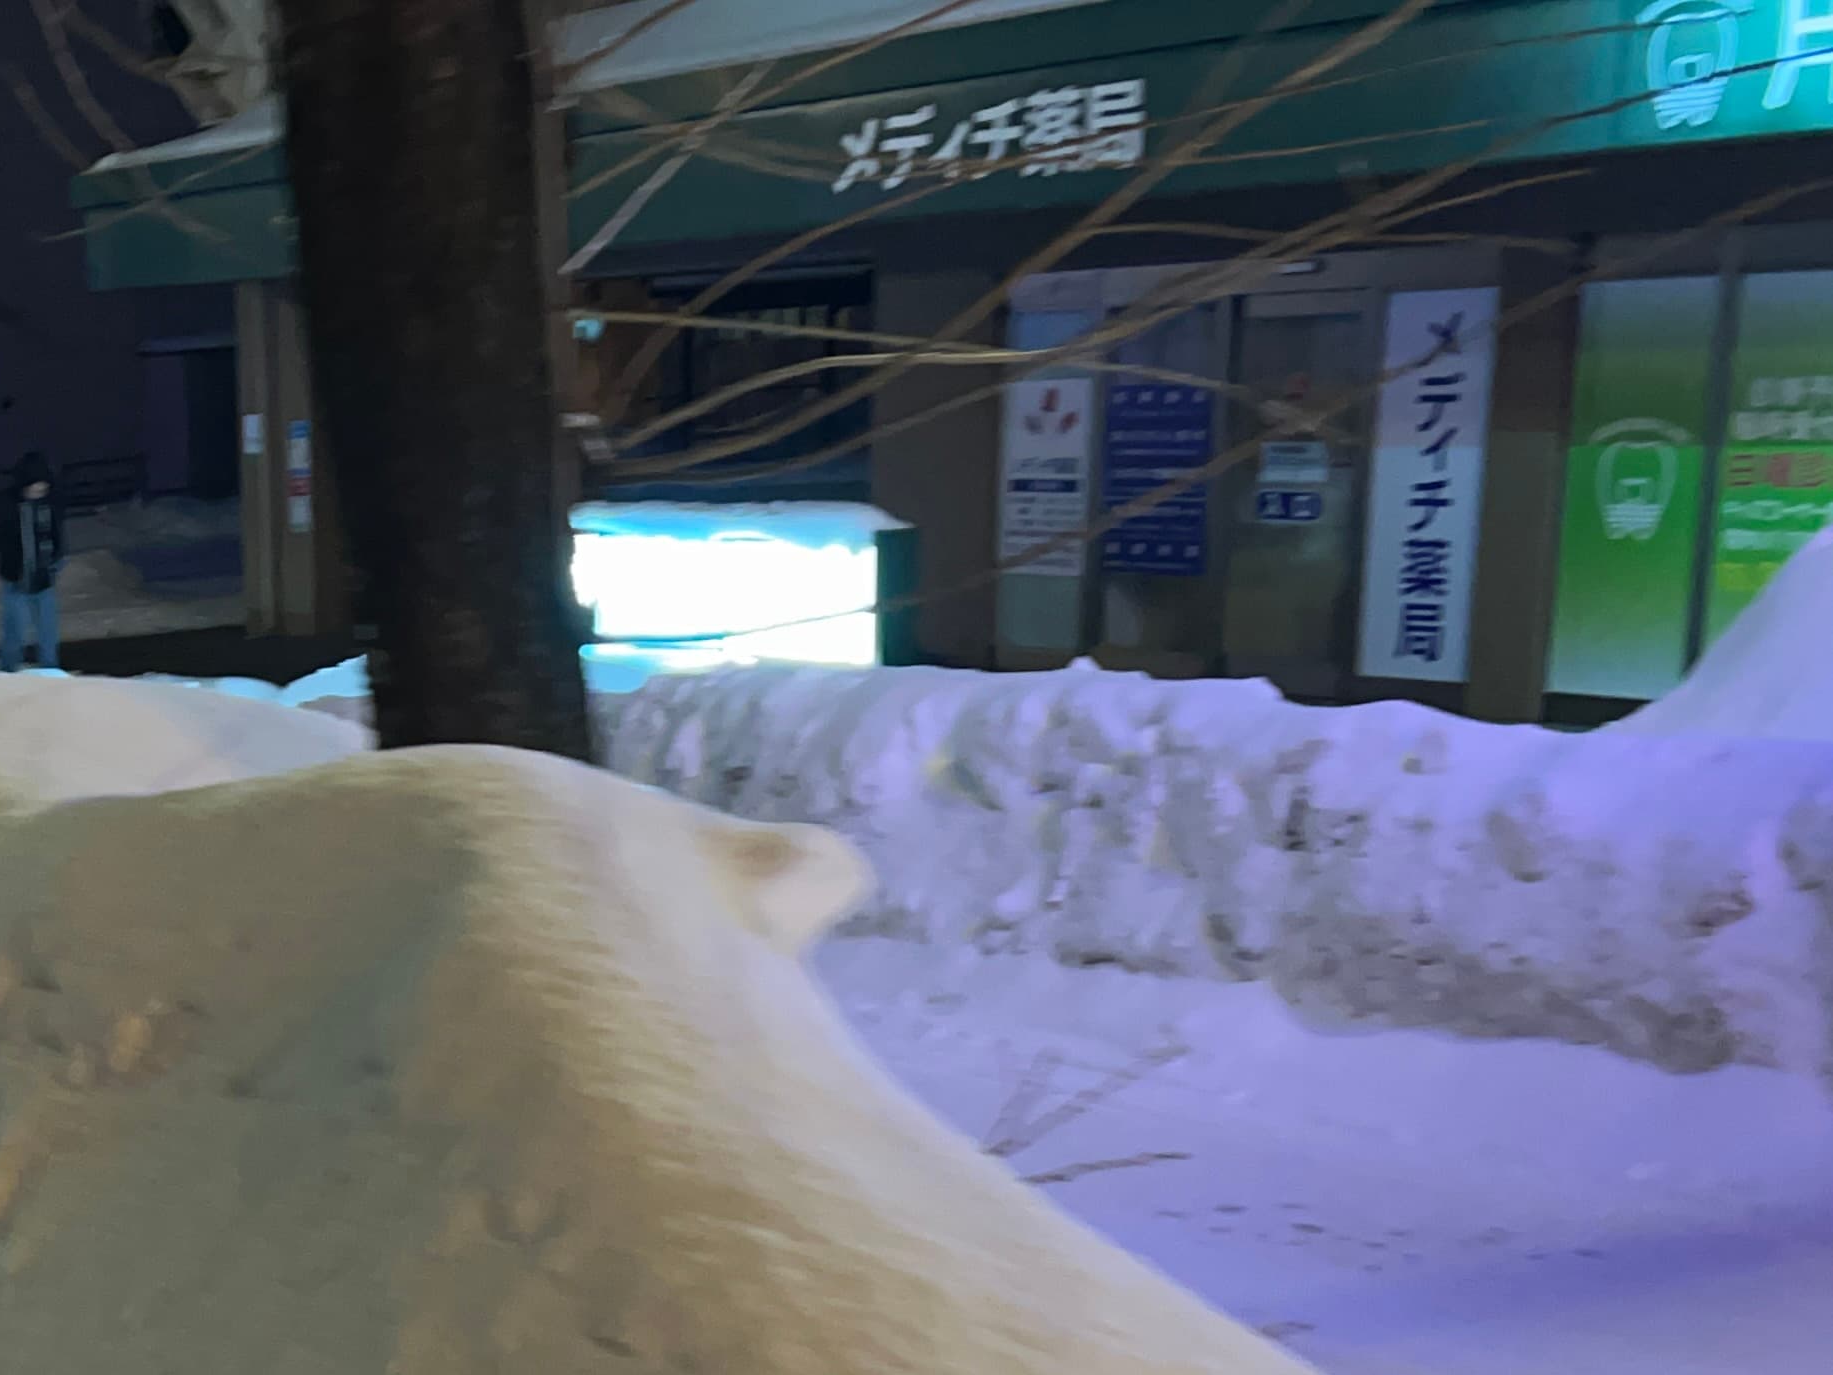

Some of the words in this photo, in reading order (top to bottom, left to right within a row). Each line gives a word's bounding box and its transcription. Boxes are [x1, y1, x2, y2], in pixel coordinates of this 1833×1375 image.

[831, 78, 1148, 194] メディチ薬局
[1391, 310, 1467, 663] メディチ薬局
